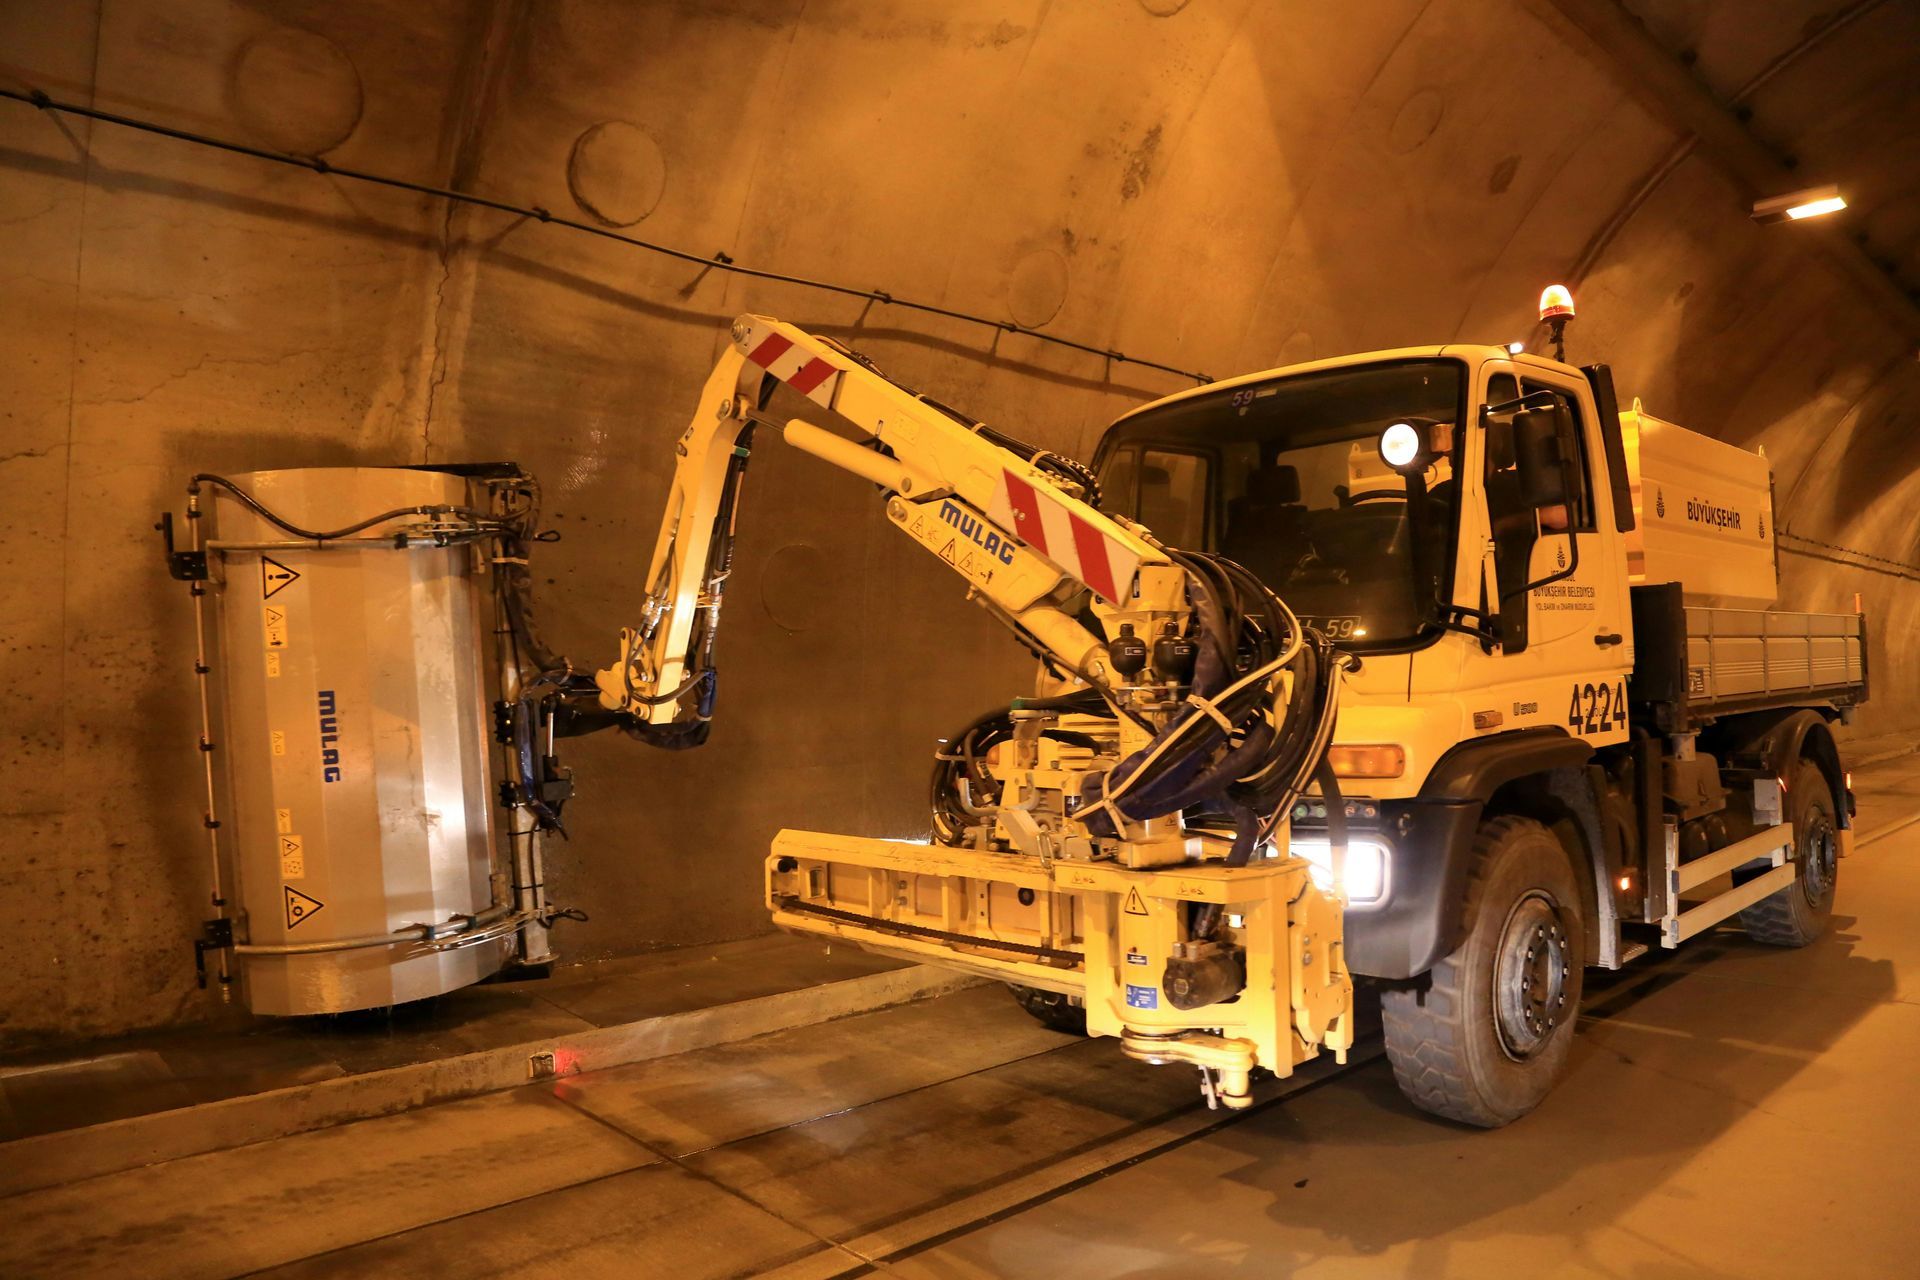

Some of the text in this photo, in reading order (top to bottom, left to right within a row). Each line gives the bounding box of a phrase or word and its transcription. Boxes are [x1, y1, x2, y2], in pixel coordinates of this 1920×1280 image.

[1232, 390, 1254, 407] 59
[939, 499, 1016, 566] MULAG
[1687, 497, 1741, 531] BÜYÜKŞEHİR
[1325, 619, 1354, 638] 59
[1569, 682, 1626, 735] 4224
[318, 690, 341, 783] MULAG
